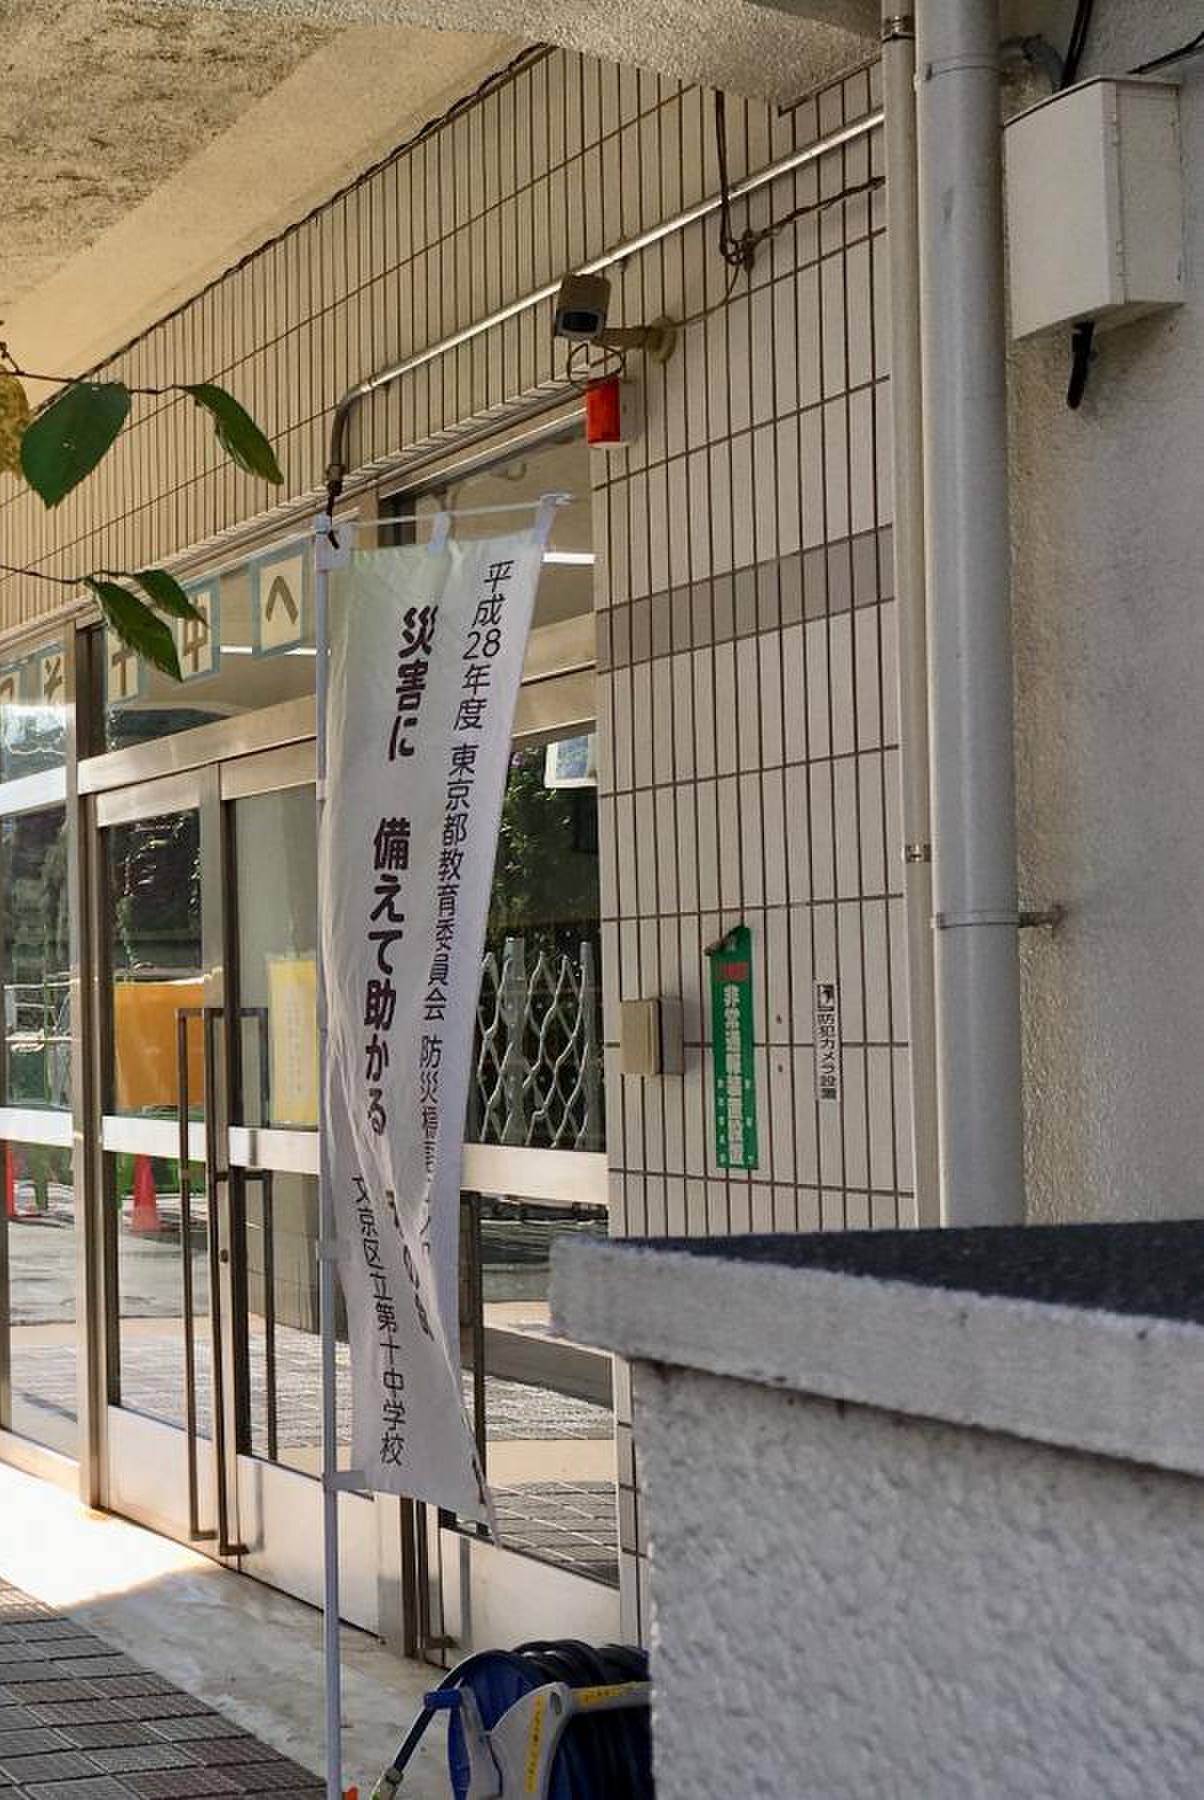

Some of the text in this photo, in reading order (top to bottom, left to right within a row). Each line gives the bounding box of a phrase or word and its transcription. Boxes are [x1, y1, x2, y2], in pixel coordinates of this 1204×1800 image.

[388, 605, 439, 762] 災害に
[452, 559, 515, 731] 平成28年度
[364, 816, 412, 1138] 備えて助かる
[424, 743, 480, 1022] 東京都教育委員会
